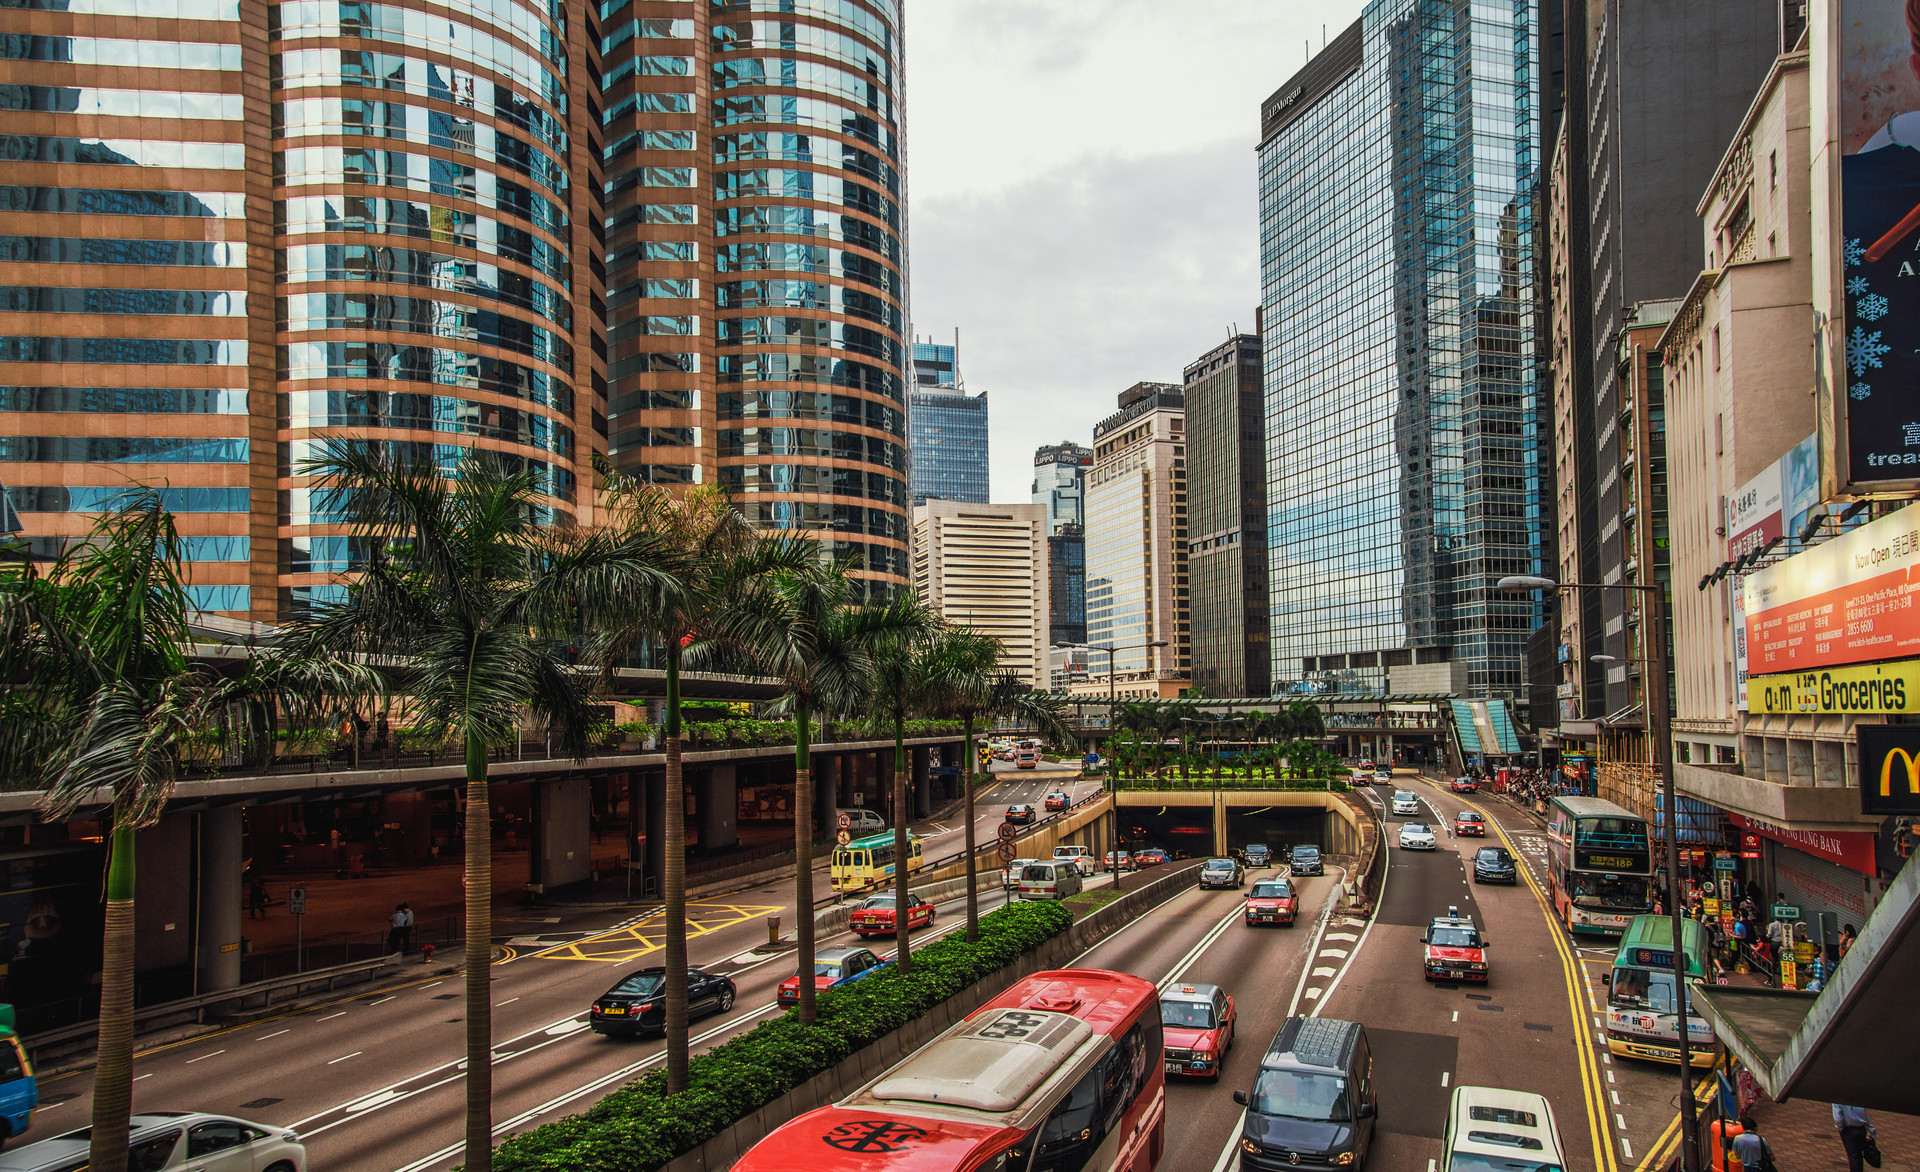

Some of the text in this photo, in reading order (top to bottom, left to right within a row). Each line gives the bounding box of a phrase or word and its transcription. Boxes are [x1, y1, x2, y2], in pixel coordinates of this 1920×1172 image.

[1267, 86, 1302, 120] J.P.Morgan
[1036, 454, 1053, 464] LIPPO
[1058, 454, 1077, 464] LIPPO
[1075, 448, 1092, 456] LIPPO
[1867, 451, 1920, 467] trea
[1893, 529, 1920, 558] 現已開
[1855, 547, 1890, 570] Now Open
[1847, 619, 1874, 636] 2855 6600
[1797, 674, 1818, 711] US
[1821, 667, 1906, 711] Groceries
[1800, 829, 1819, 848] LUNG
[1820, 834, 1843, 857] BANK
[1640, 952, 1650, 960] 55
[1782, 953, 1795, 961] 55
